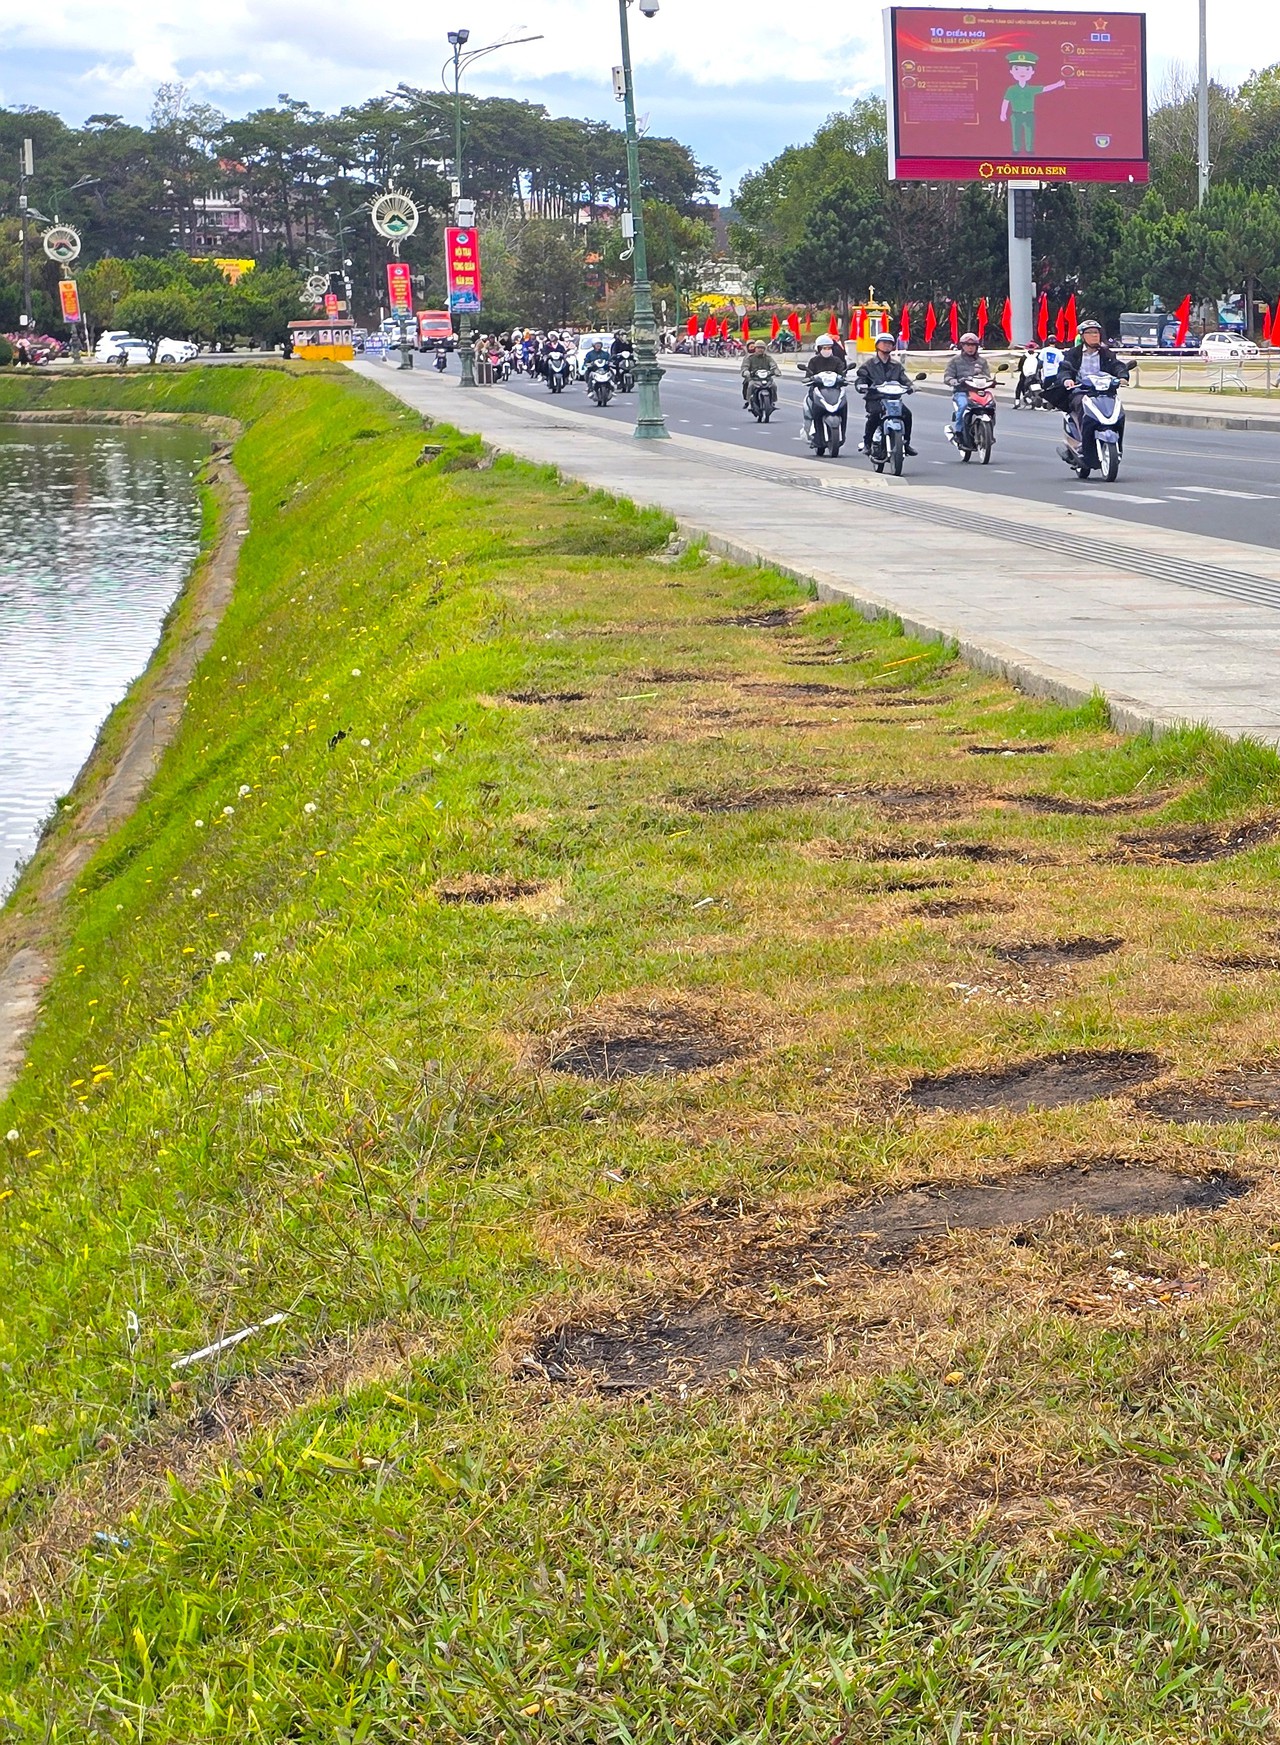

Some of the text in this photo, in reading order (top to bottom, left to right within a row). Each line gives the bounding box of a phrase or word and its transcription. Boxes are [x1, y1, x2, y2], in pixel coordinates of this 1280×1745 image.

[930, 28, 944, 36] 10
[917, 65, 925, 73] 01
[1076, 69, 1085, 77] 04
[917, 80, 926, 88] 02
[996, 163, 1066, 175] TÔN HOA SEN
